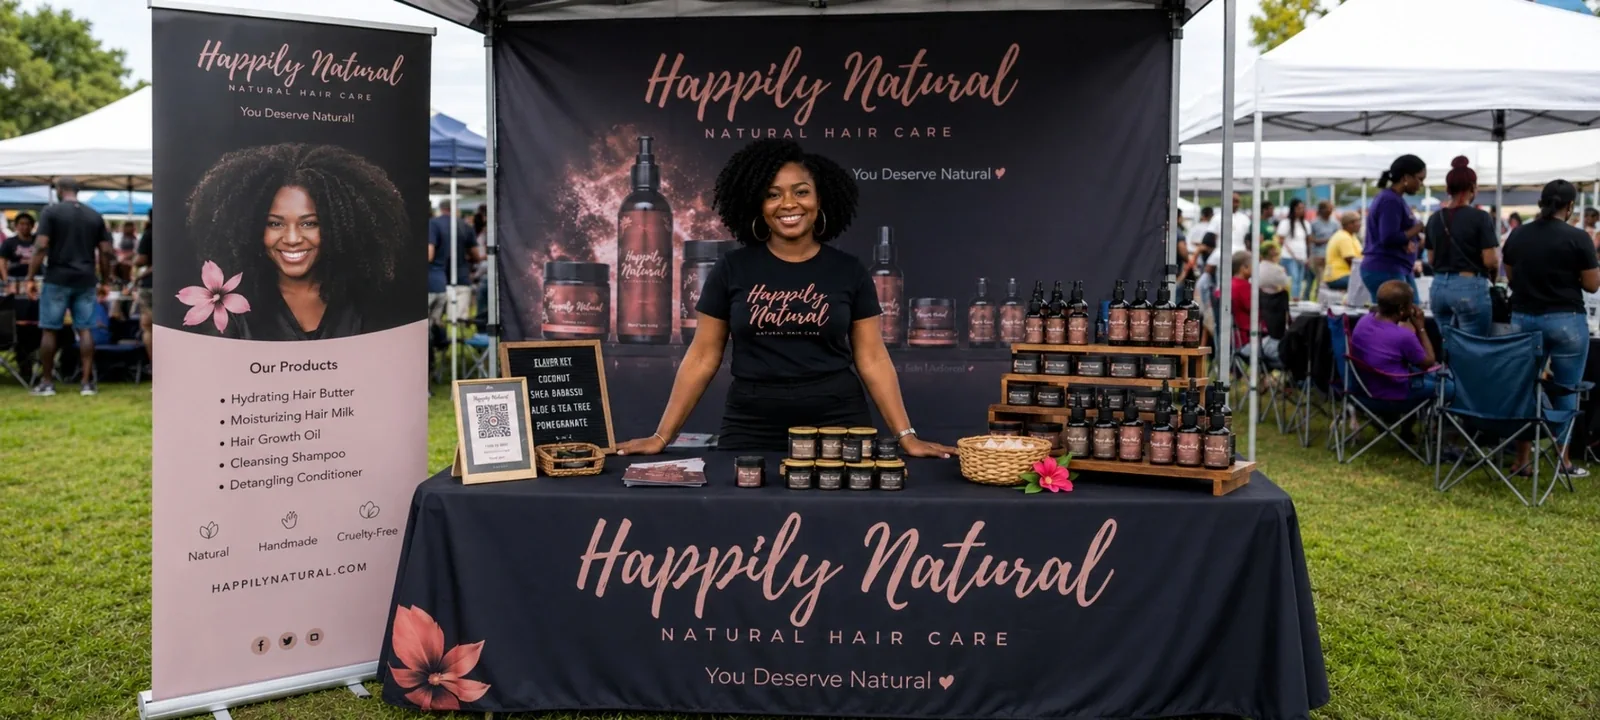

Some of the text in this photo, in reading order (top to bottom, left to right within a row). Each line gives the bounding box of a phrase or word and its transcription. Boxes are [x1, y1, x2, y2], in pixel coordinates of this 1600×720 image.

[197, 39, 404, 88] Happily Natural
[228, 83, 372, 101] NATURAL HAIR CARE
[645, 43, 1020, 126] Happily Natural
[240, 106, 355, 123] You Deserve Natural!
[705, 127, 952, 139] NATURAL HAIR CARE
[852, 168, 991, 181] You Deserve Natural
[625, 249, 664, 267] Happily
[621, 261, 667, 280] Natural
[746, 282, 829, 309] Happily
[749, 302, 829, 329] Natural
[249, 359, 339, 374] Our Products
[560, 356, 572, 367] KEY
[538, 373, 570, 384] COCONUT
[231, 387, 355, 407] Hydrating Hair Butter
[530, 387, 584, 399] SHEA BABASSU
[230, 406, 355, 426] Moisturizing Hair Milk
[531, 404, 549, 415] ALOE
[557, 403, 572, 413] TEA
[573, 402, 592, 412] TREE
[536, 418, 588, 430] POMEGRANATE
[230, 429, 321, 447] Hair Growth Oil
[230, 450, 346, 470] Cleansing Shampoo
[230, 468, 363, 490] Detangling Conditioner
[336, 526, 399, 542] Cruelty-Free
[258, 536, 318, 552] Handmade
[188, 547, 230, 562] Natural
[211, 562, 368, 594] HAPPILYNATURAL.COM
[576, 511, 1118, 629] Happily Natural
[661, 627, 1008, 647] NATURAL HAIR CARE
[705, 667, 931, 690] You Deserve Natural
